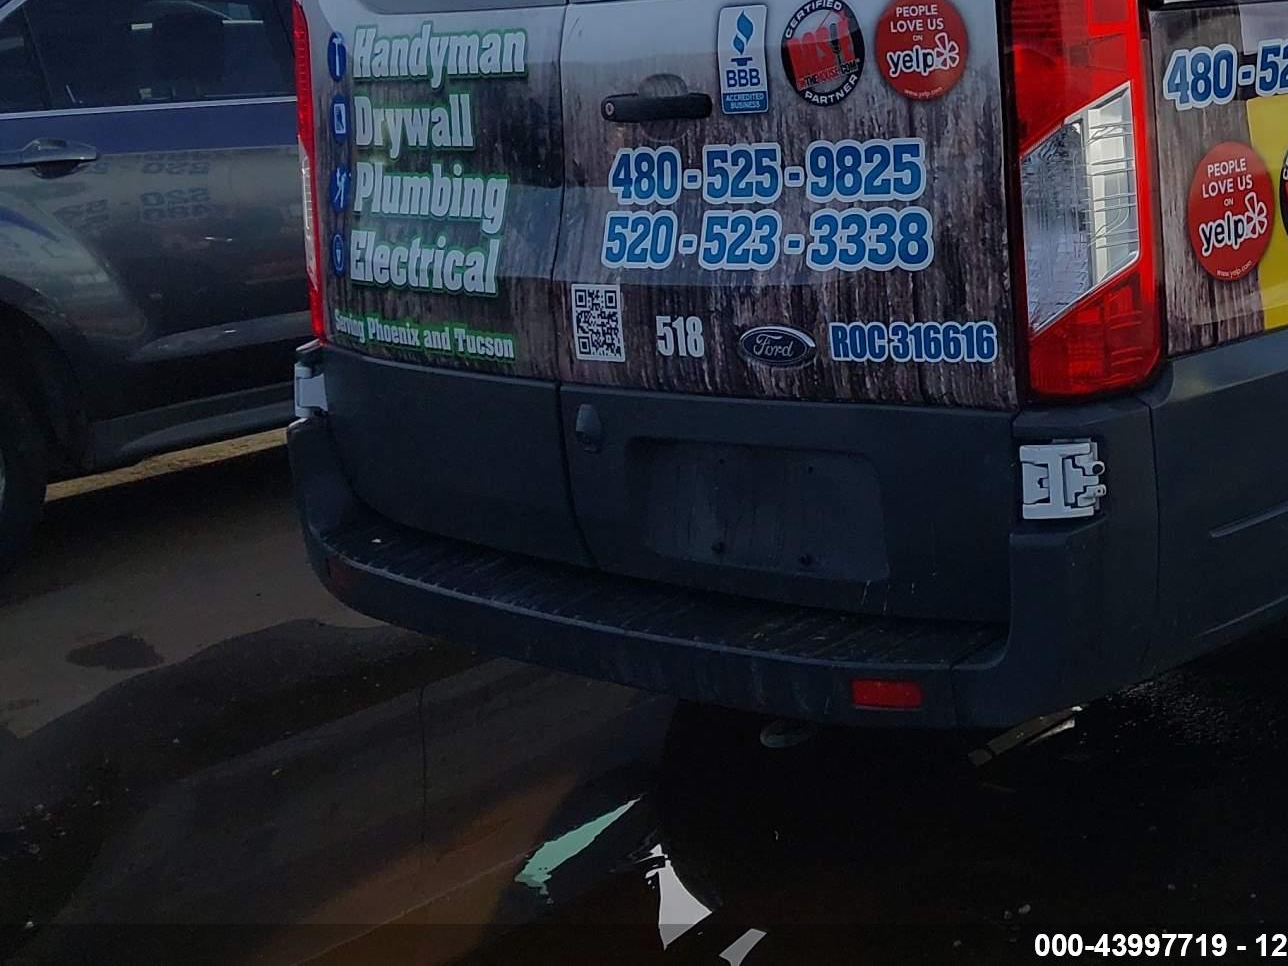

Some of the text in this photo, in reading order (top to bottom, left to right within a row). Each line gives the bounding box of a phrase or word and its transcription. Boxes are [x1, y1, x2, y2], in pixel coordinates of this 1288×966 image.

[785, 0, 842, 38] CERTIFIED
[890, 18, 944, 33] LOVE US
[896, 5, 938, 17] PEOPLE
[352, 22, 527, 90] Handyman
[887, 45, 936, 76] yelp
[726, 68, 761, 88] BBB
[805, 74, 858, 104] PARTNER
[725, 92, 765, 102] ACCREDITED
[729, 101, 760, 109] BUSINESS
[353, 93, 474, 160] Drywall
[609, 139, 925, 203] 480-525-9825
[1202, 174, 1252, 198] LOVE US
[1207, 158, 1247, 178] PEOPLE
[354, 163, 510, 234] Plumbing
[603, 208, 933, 270] 520-523-3338
[1199, 212, 1246, 257] yelp
[350, 229, 500, 297] Electrical
[334, 308, 515, 359] Serving Phoenix and Tucson
[656, 315, 705, 358] 518
[753, 333, 794, 357] Ford
[889, 322, 996, 359] 316616
